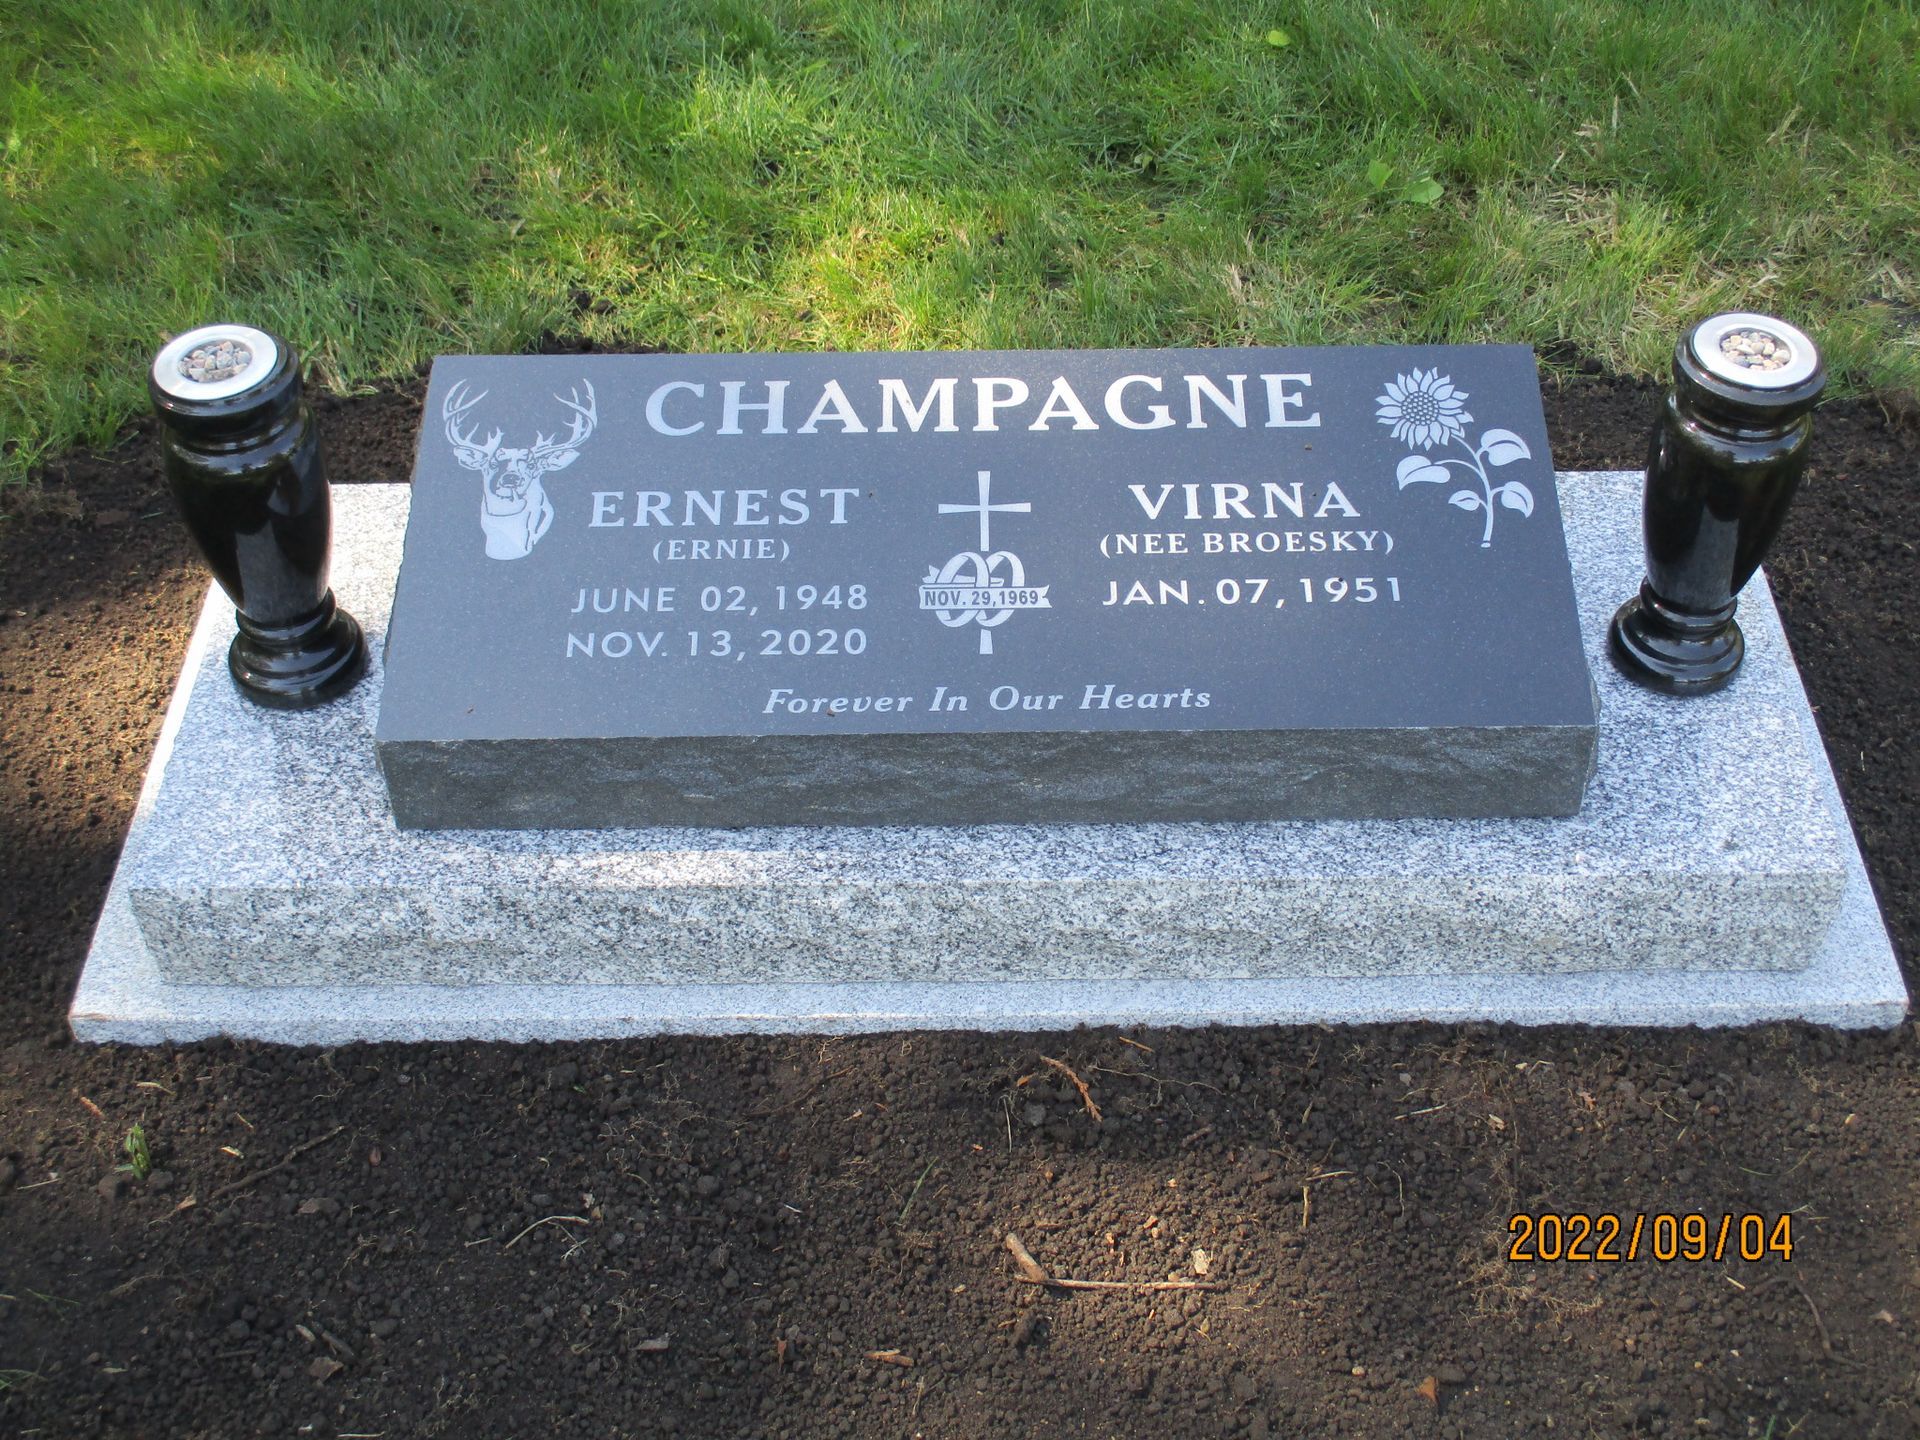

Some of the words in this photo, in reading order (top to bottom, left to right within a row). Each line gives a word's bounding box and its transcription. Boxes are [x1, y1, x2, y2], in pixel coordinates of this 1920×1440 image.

[645, 373, 1321, 436] CHAMPAGNE
[588, 488, 859, 528] ERNEST
[1128, 481, 1361, 520] VIRNA
[652, 538, 790, 563] (ERNIE)
[1100, 533, 1188, 558] (NEE
[1203, 530, 1394, 555] BROESKY)
[571, 586, 676, 613] JUNE
[700, 585, 759, 616] 02,
[776, 584, 868, 610] 1948
[1103, 579, 1205, 606] JAN.
[1299, 577, 1401, 602] 1951
[566, 631, 668, 658] NOV.
[688, 630, 745, 661] 13,
[759, 628, 867, 656] 2020
[762, 688, 913, 715] Forever
[929, 686, 968, 712] In
[989, 685, 1063, 710] Our
[1079, 684, 1211, 710] Hearts
